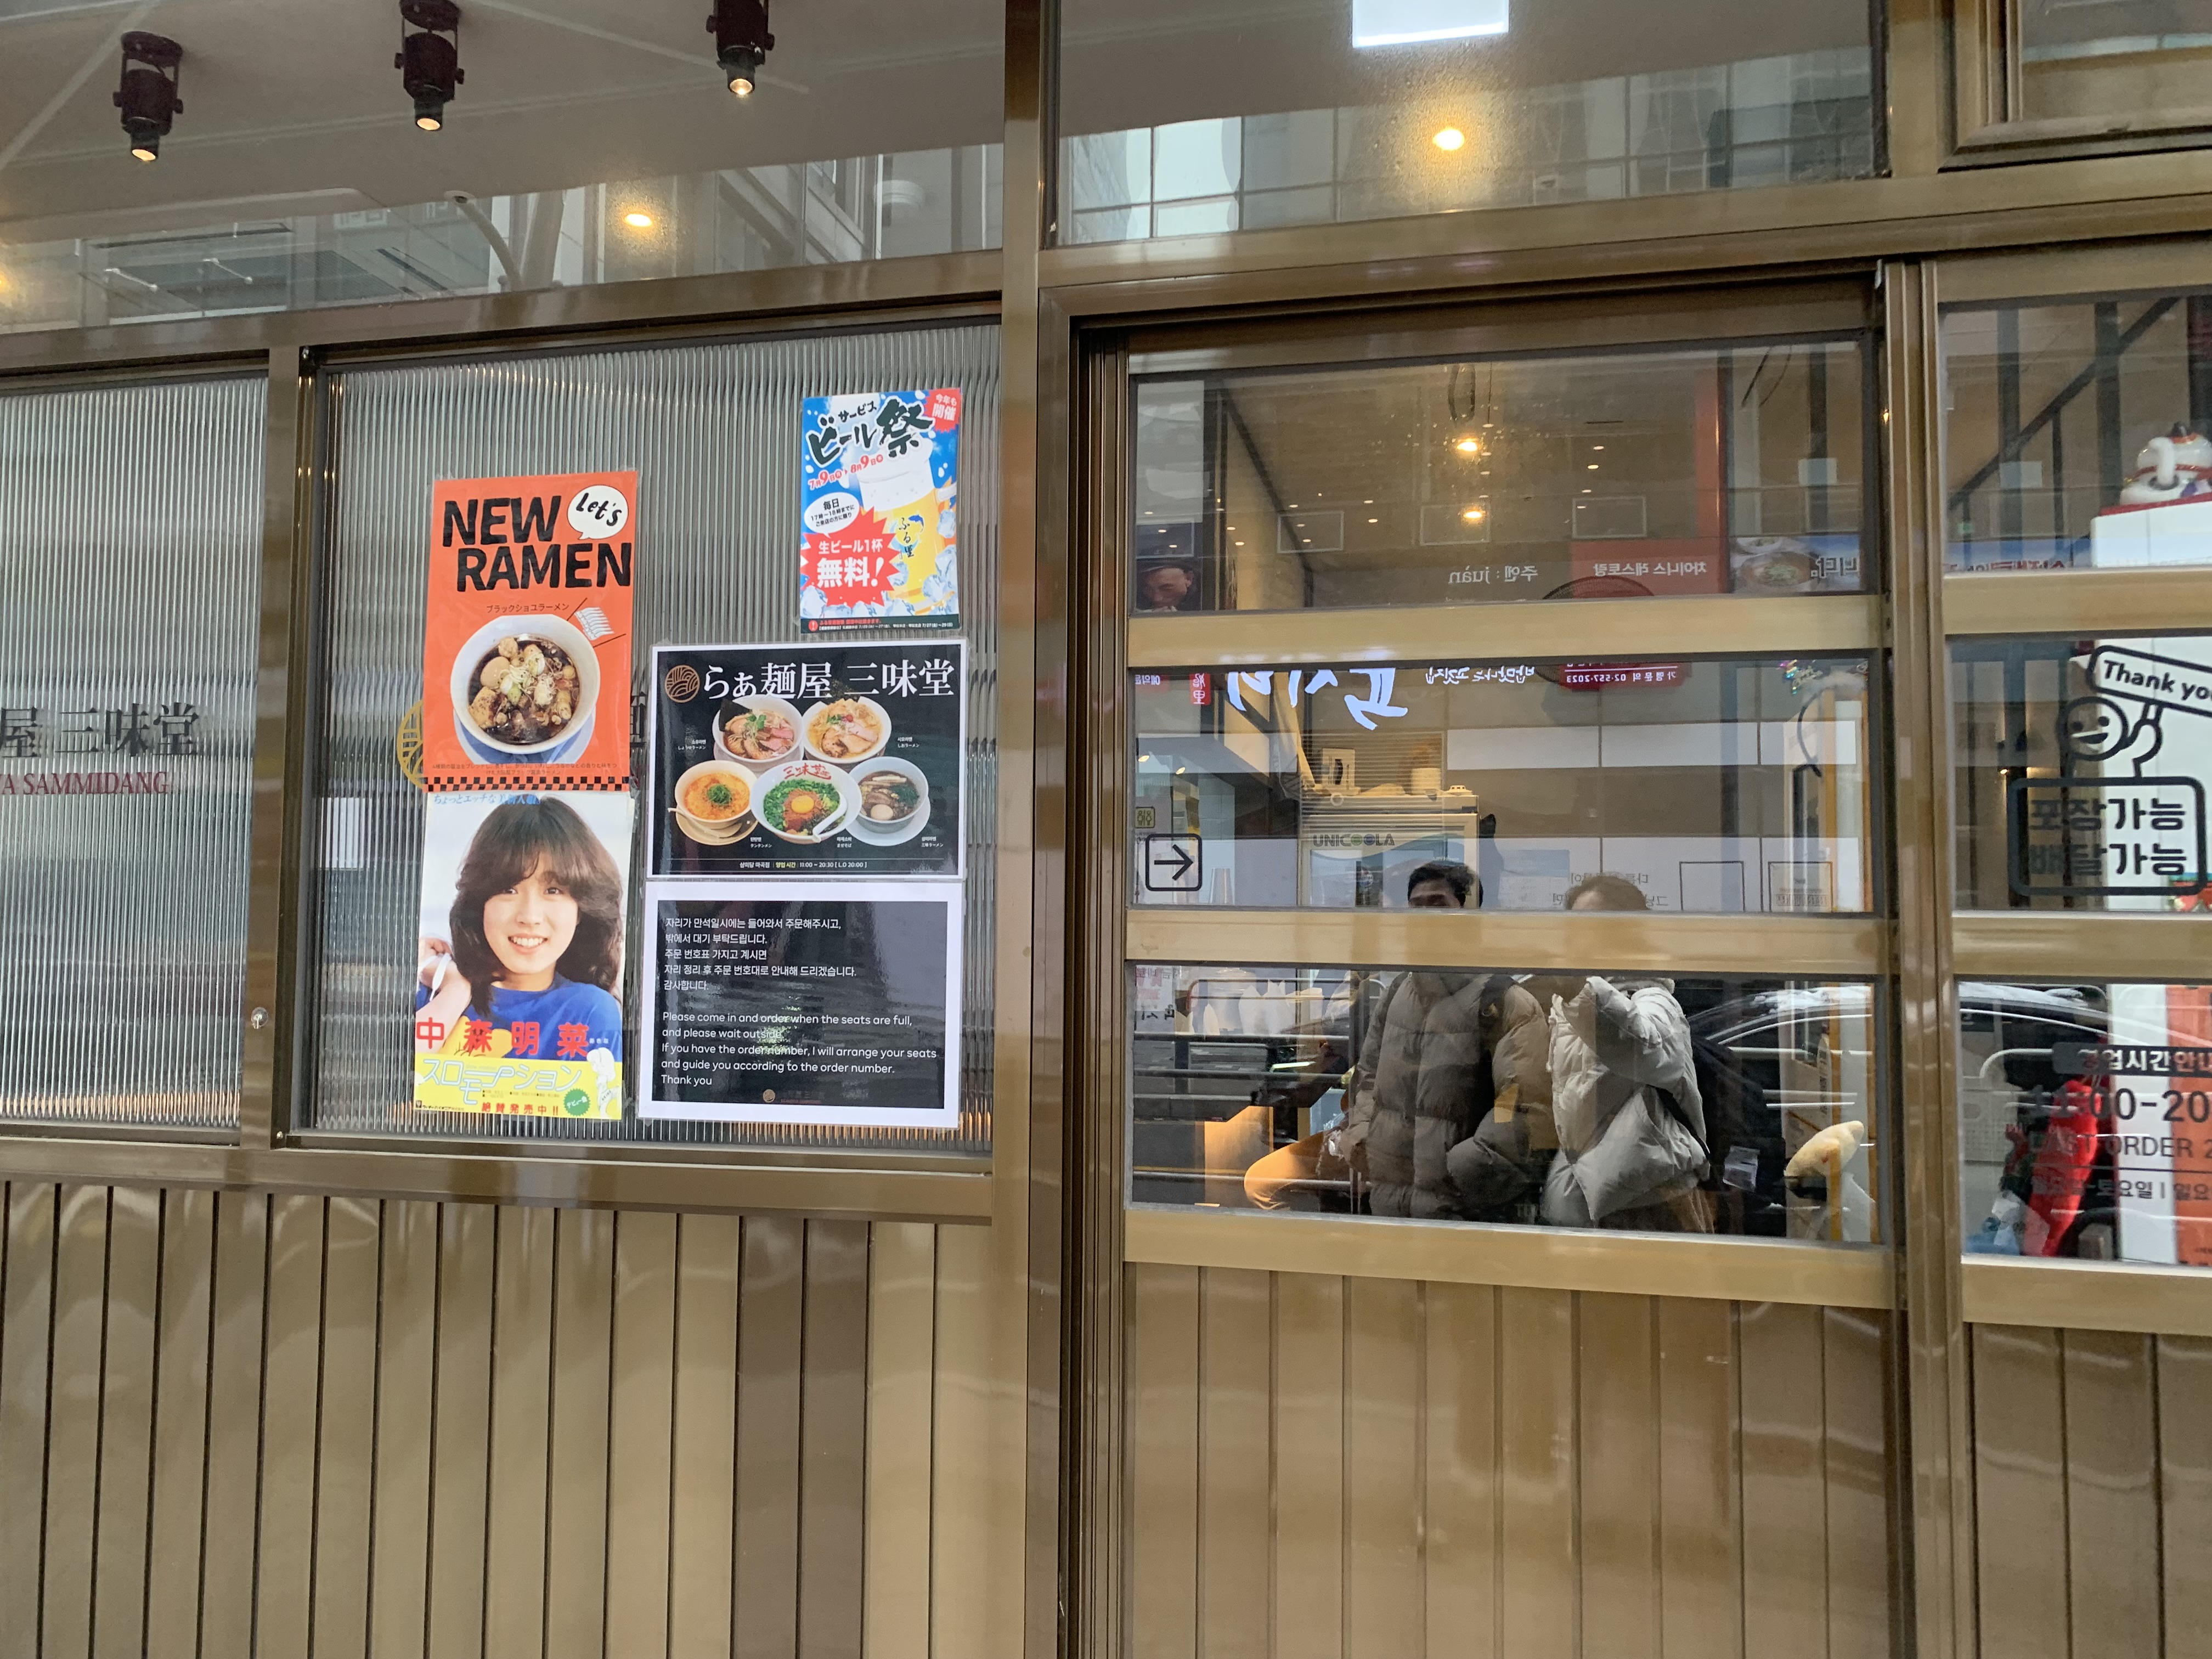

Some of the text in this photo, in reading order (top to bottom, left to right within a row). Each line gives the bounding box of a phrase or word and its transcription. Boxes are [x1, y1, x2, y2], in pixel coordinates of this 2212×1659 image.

[935, 394, 957, 406] 今年も
[838, 401, 877, 422] サービス
[933, 403, 956, 421] 開催
[576, 493, 622, 526] Let's
[823, 498, 839, 510] 毎日
[443, 495, 562, 546] NEW
[819, 539, 883, 555] 生ビール1杯
[458, 543, 631, 592] RAMEN
[487, 603, 569, 613] ブラックショユラーメン
[704, 659, 954, 699] らぁ麺屋 三味堂
[2103, 659, 2212, 701] Thank yo
[0, 771, 170, 795] A SAMMIDANG
[665, 918, 841, 929] 자리가 만석일시에는 들어와서 주문해주시고,
[665, 934, 768, 944] 밖에서 대기 부탁드립니다.
[664, 949, 767, 960] 주문 번호표 가지고 계시면
[664, 964, 856, 977] 자리 정리 후 주문 번호대로 안내해 드리겠습니다.
[664, 980, 709, 991] 감사합니다.
[663, 1012, 912, 1026] Please come in and order when the seats are full,
[415, 1017, 589, 1058] 中森明菜
[662, 1028, 681, 1037] and
[684, 1029, 716, 1039] please
[718, 1029, 741, 1038] wait
[662, 1043, 669, 1052] If
[670, 1046, 689, 1054] you
[691, 1044, 716, 1053] have
[718, 1045, 736, 1054] the
[738, 1045, 764, 1054] order
[768, 1046, 810, 1057] number,
[817, 1047, 834, 1056] will
[836, 1048, 878, 1059] arrange
[881, 1049, 905, 1059] your
[907, 1049, 937, 1058] seats
[661, 1059, 895, 1073] and guide you according to the order number.
[661, 1075, 712, 1087] Thank you
[2106, 1136, 2194, 1158] ORDER
